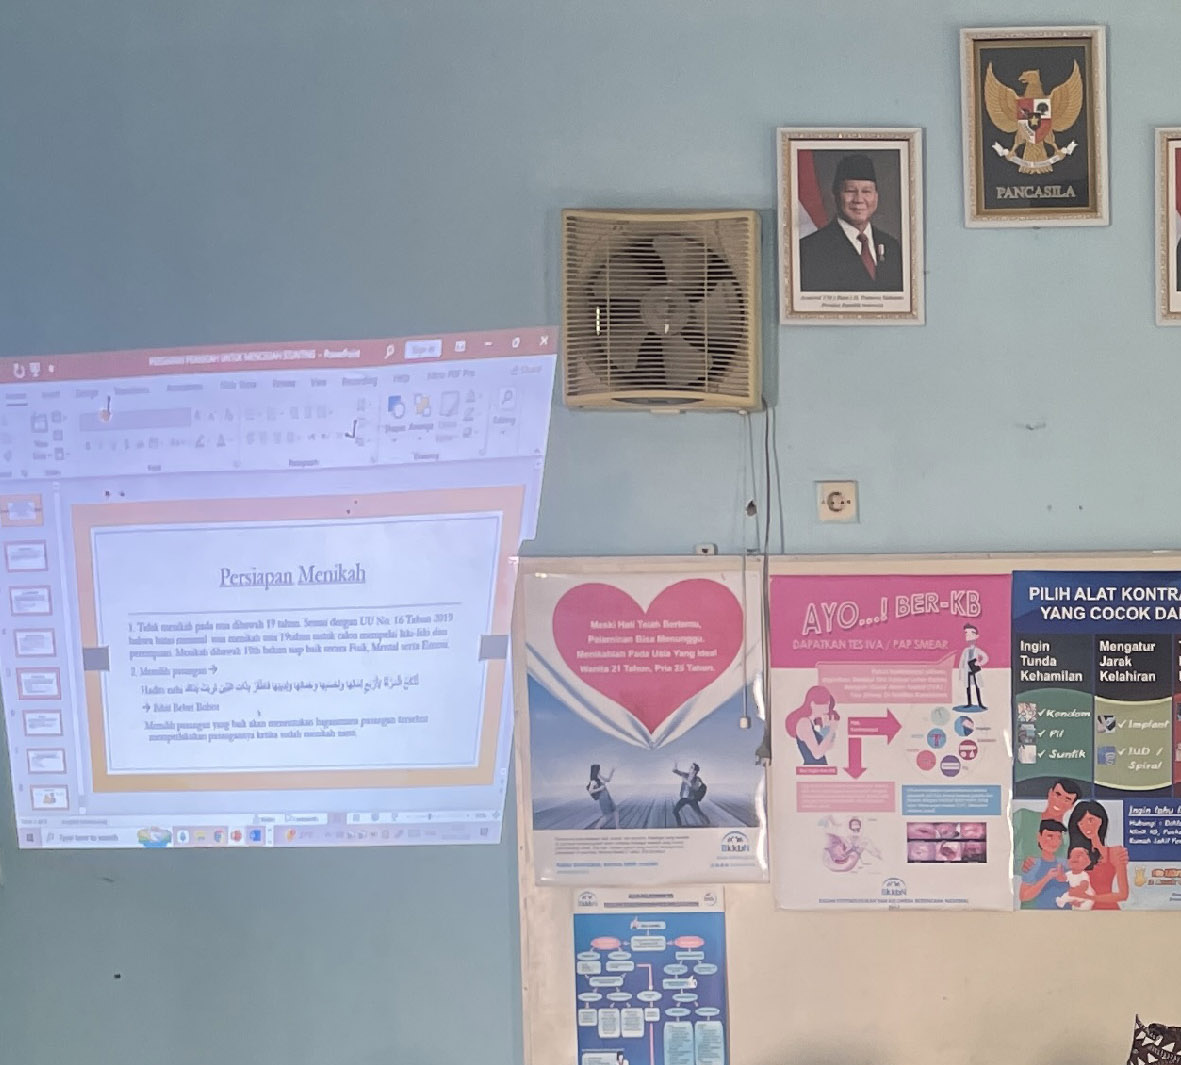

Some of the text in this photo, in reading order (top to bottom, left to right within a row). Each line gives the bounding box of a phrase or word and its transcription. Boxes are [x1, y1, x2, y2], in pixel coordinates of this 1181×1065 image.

[996, 185, 1077, 200] PANCASILA
[220, 562, 367, 591] Persiapan Menikah
[1028, 586, 1070, 601] PILIH
[1073, 586, 1118, 601] ALAT
[895, 589, 982, 618] BER-KB
[1040, 606, 1087, 620] YANG
[1089, 606, 1152, 620] COCOK
[792, 639, 847, 651] DAPATKAN
[849, 638, 864, 651] TES
[866, 639, 884, 650] IVA
[893, 639, 913, 650] PAP
[914, 639, 949, 651] SMEAR
[1020, 640, 1051, 653] Ingin
[1099, 640, 1156, 653] Mengatur
[1020, 655, 1058, 667] Tunda
[1099, 655, 1133, 667] Jarak
[1020, 670, 1083, 682] Kehamilan
[1099, 670, 1156, 682] Kelahiran
[1128, 719, 1171, 731] Implant
[1048, 748, 1087, 760] Suntik
[1127, 760, 1163, 771] Spiral
